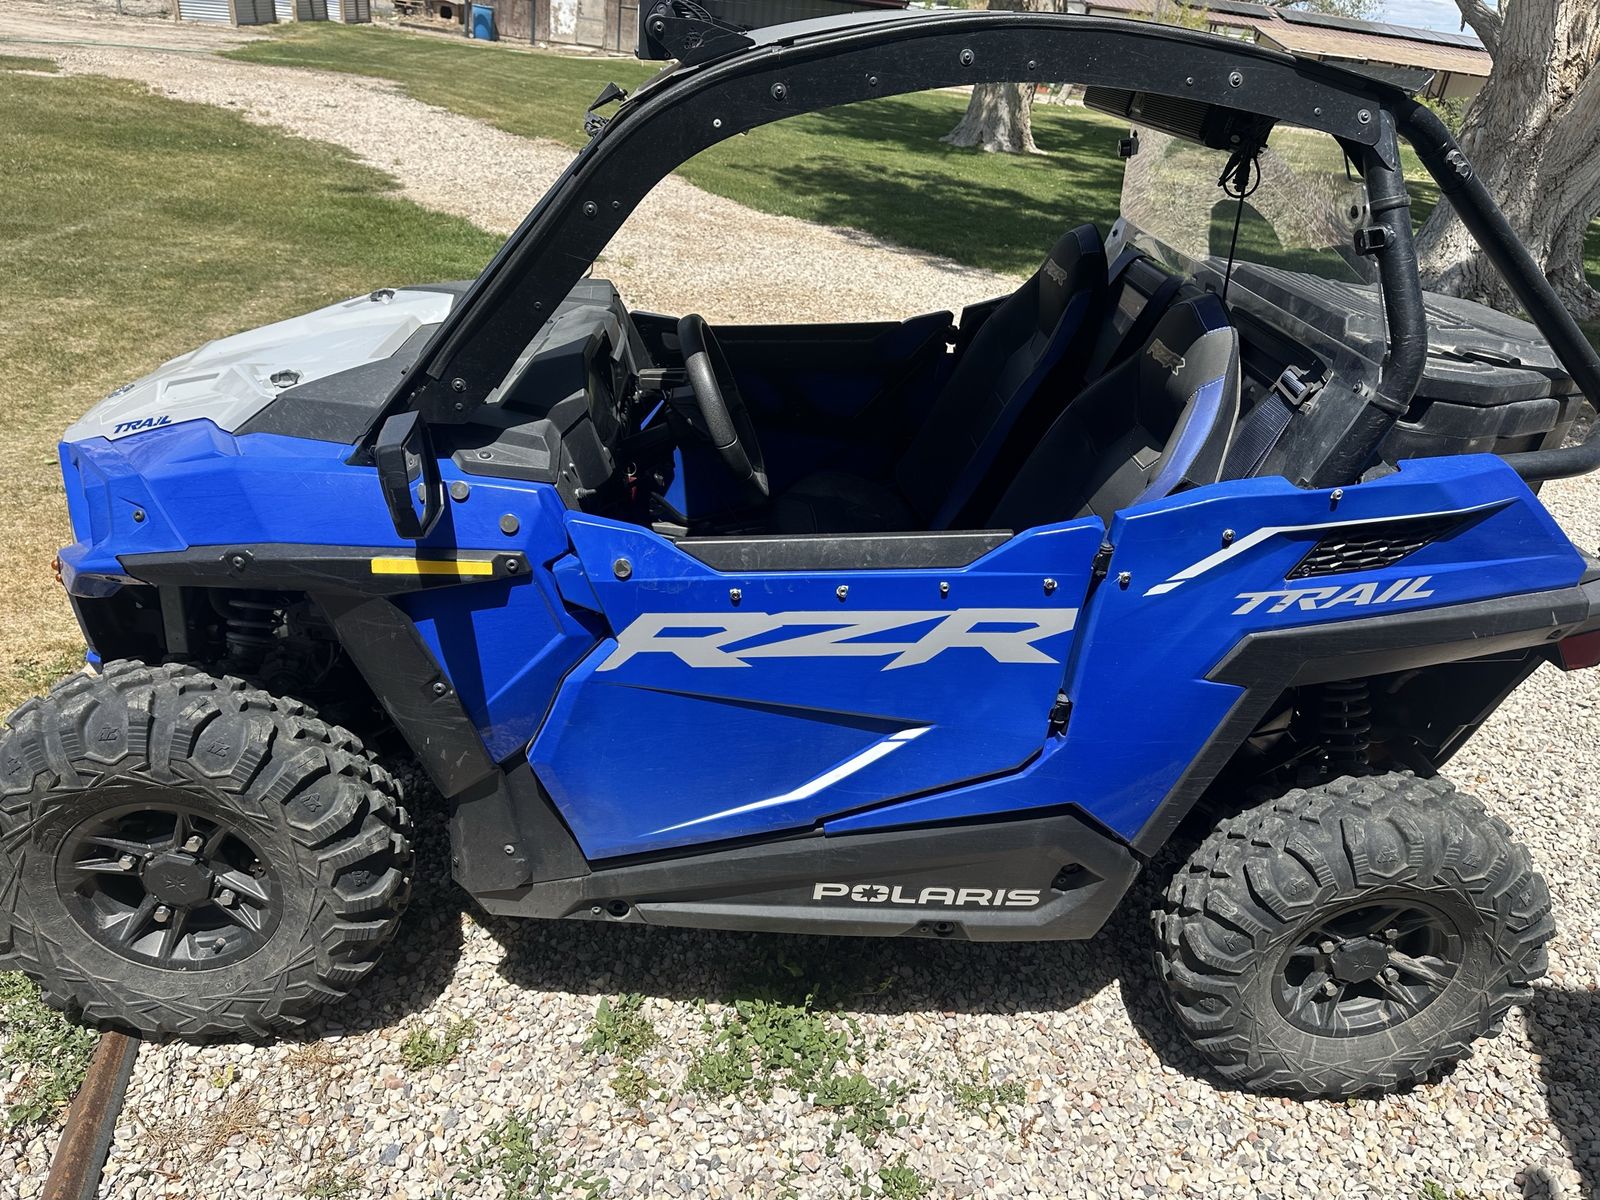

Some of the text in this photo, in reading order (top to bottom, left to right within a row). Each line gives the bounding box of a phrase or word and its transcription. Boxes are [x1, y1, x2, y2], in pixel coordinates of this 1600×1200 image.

[113, 415, 172, 434] TRAIL
[1231, 575, 1435, 615] TRAIL
[595, 607, 1079, 672] RZR
[812, 882, 1041, 906] POLARIS
